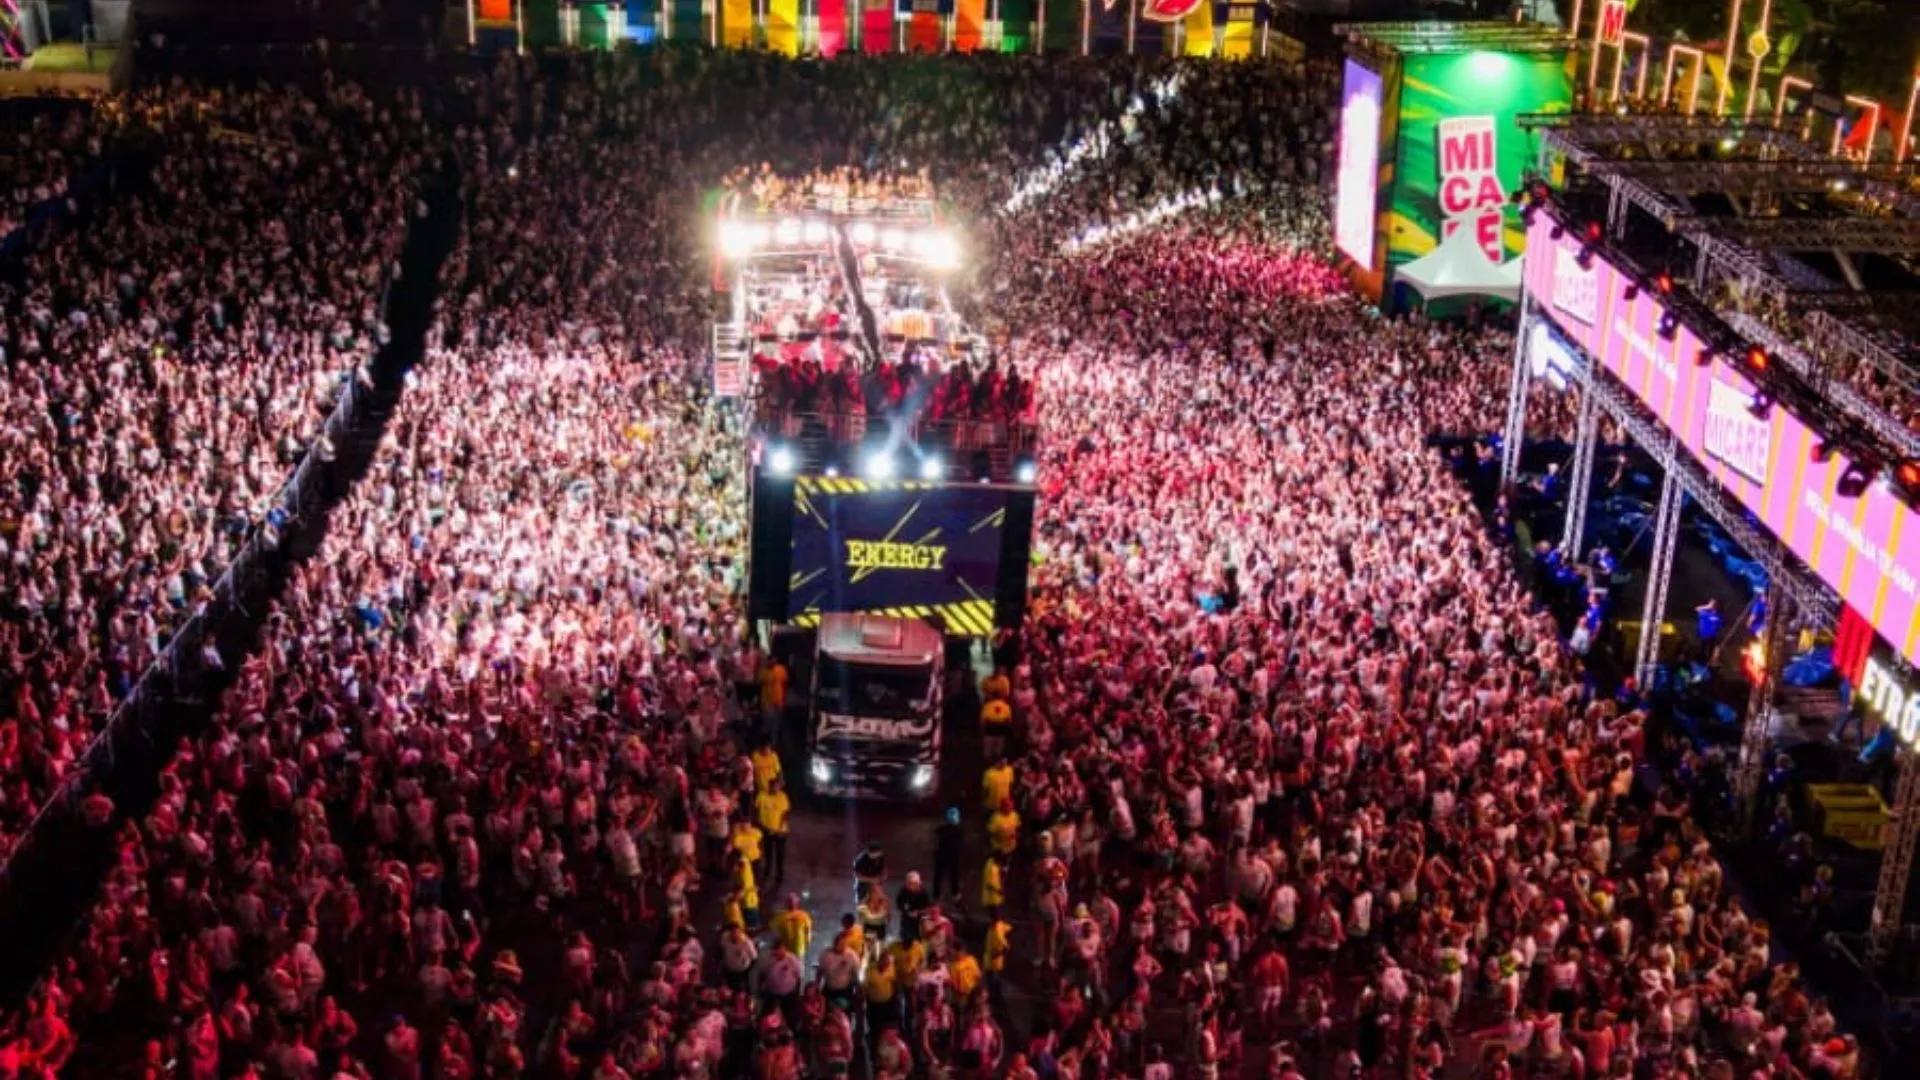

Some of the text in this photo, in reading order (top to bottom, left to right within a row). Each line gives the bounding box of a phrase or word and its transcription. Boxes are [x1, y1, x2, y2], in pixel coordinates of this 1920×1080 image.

[1445, 131, 1493, 172] MI
[1445, 176, 1503, 213] CA
[846, 540, 947, 569] ENERGY
